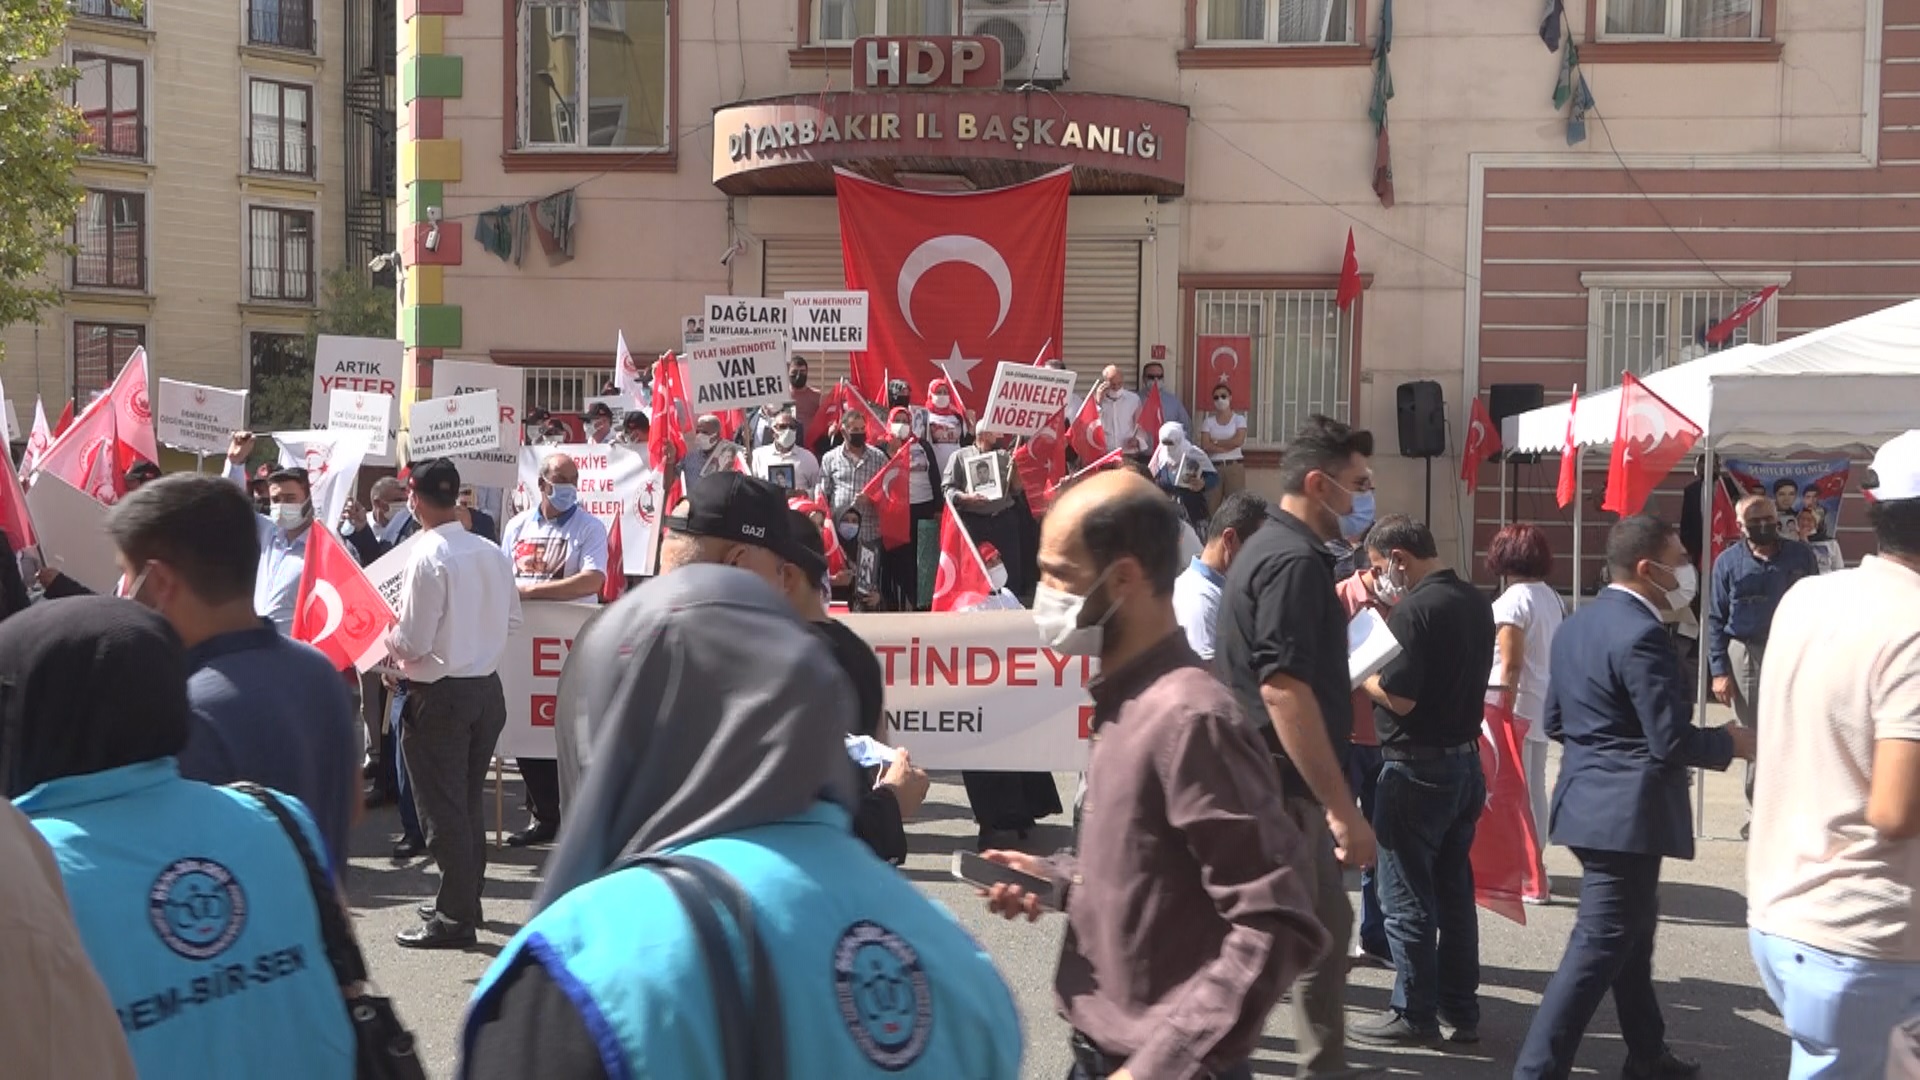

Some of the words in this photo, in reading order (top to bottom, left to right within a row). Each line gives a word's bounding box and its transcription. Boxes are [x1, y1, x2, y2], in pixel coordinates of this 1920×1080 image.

[866, 41, 985, 85] HDP
[728, 113, 901, 162] DİYARBAKIR
[958, 114, 1162, 161] BAŞKANLIĞI
[792, 297, 811, 306] VLAT
[711, 301, 787, 324] DAĞLARI
[809, 308, 841, 324] VAN
[693, 349, 718, 360] EVLAT
[335, 361, 381, 375] ARTIK
[717, 356, 756, 379] VAN
[998, 381, 1067, 407] ANNELER
[599, 479, 614, 492] VE
